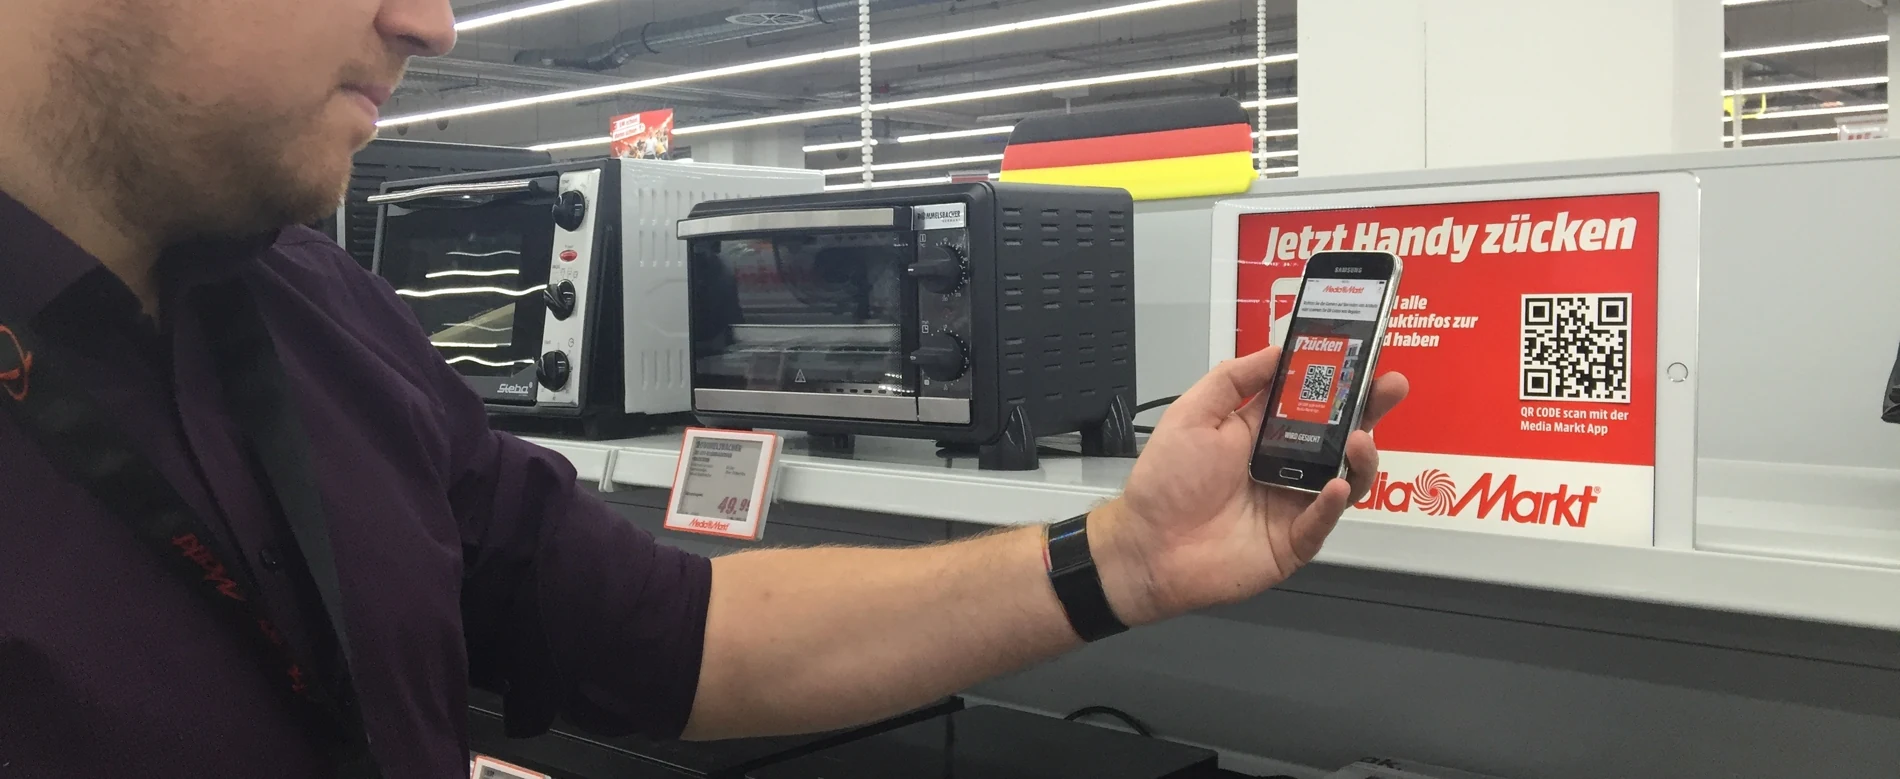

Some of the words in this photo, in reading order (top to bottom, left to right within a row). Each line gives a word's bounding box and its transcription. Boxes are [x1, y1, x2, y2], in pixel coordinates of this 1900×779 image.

[1262, 224, 1348, 266] Jetzt
[1353, 217, 1479, 263] Handy
[1481, 211, 1637, 254] zücken
[1400, 295, 1428, 310] alle
[1388, 313, 1451, 328] uktinfos
[1452, 316, 1479, 328] zur
[1302, 337, 1343, 352] zücken
[1393, 332, 1440, 347] haben
[1521, 406, 1534, 418] QR
[1536, 407, 1561, 418] CODE
[1563, 409, 1586, 419] scan
[1589, 409, 1608, 420] mit
[1610, 410, 1629, 420] der
[1521, 420, 1552, 432] Media
[1554, 422, 1585, 433] Markt
[1587, 424, 1608, 436] App
[1353, 472, 1413, 512] dia
